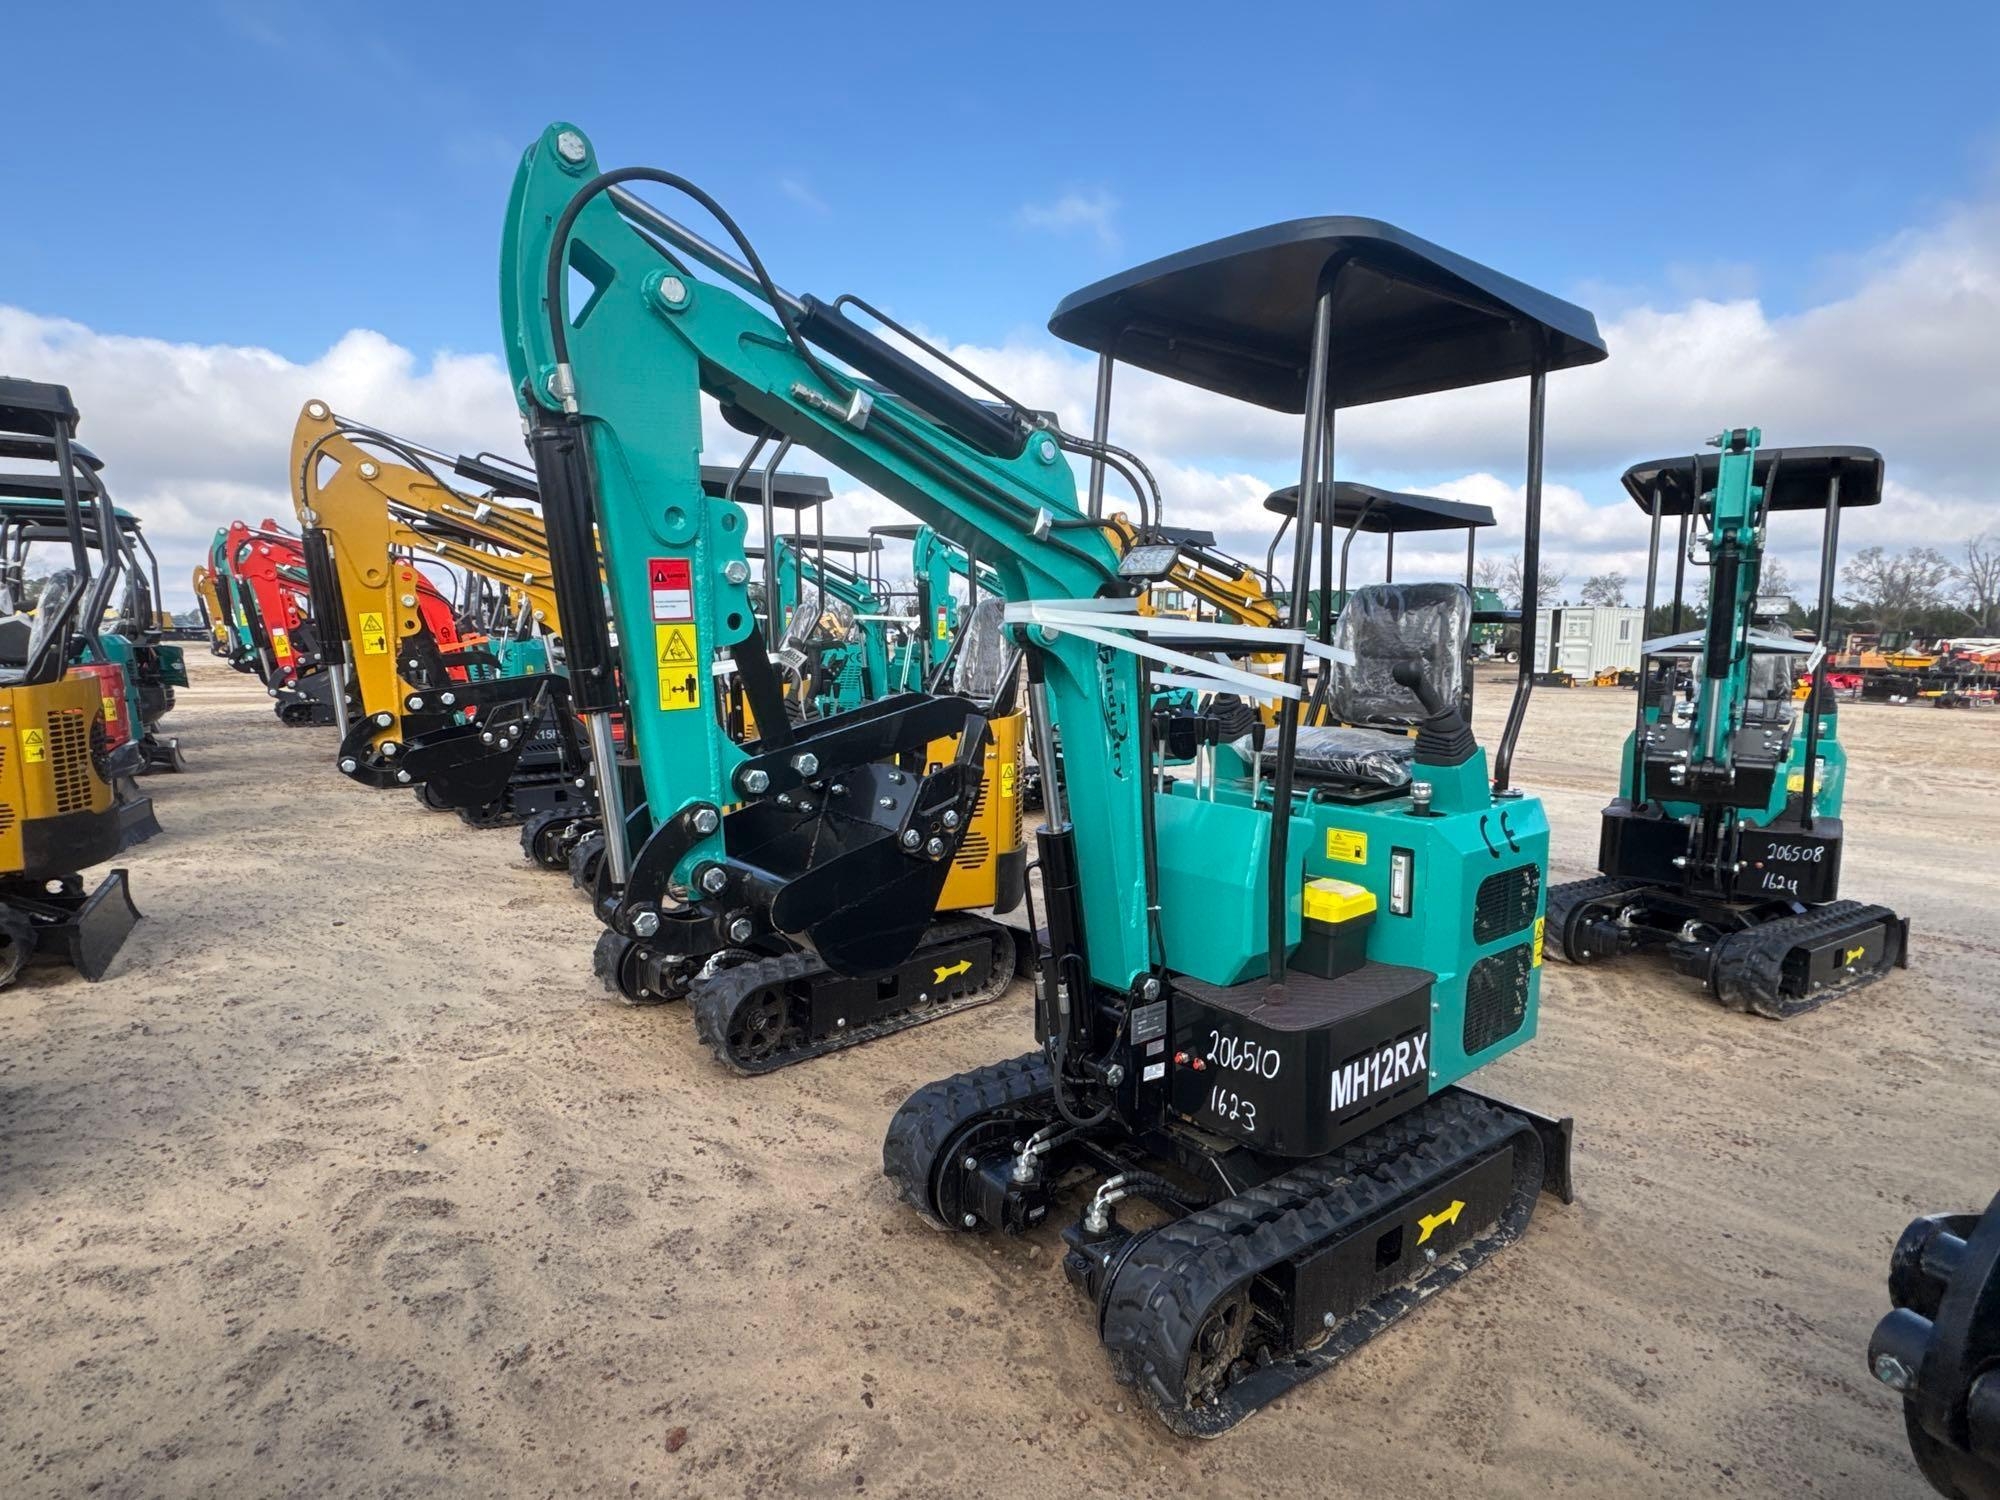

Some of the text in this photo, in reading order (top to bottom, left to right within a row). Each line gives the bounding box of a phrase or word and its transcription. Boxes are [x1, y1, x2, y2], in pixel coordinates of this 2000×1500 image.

[1480, 811, 1520, 858] CE
[1767, 843, 1825, 862] 206508
[1762, 872, 1799, 895] 1624
[1206, 1030, 1280, 1079] 206510
[1330, 1032, 1428, 1112] MH12RX
[1211, 1085, 1256, 1131] 1623
